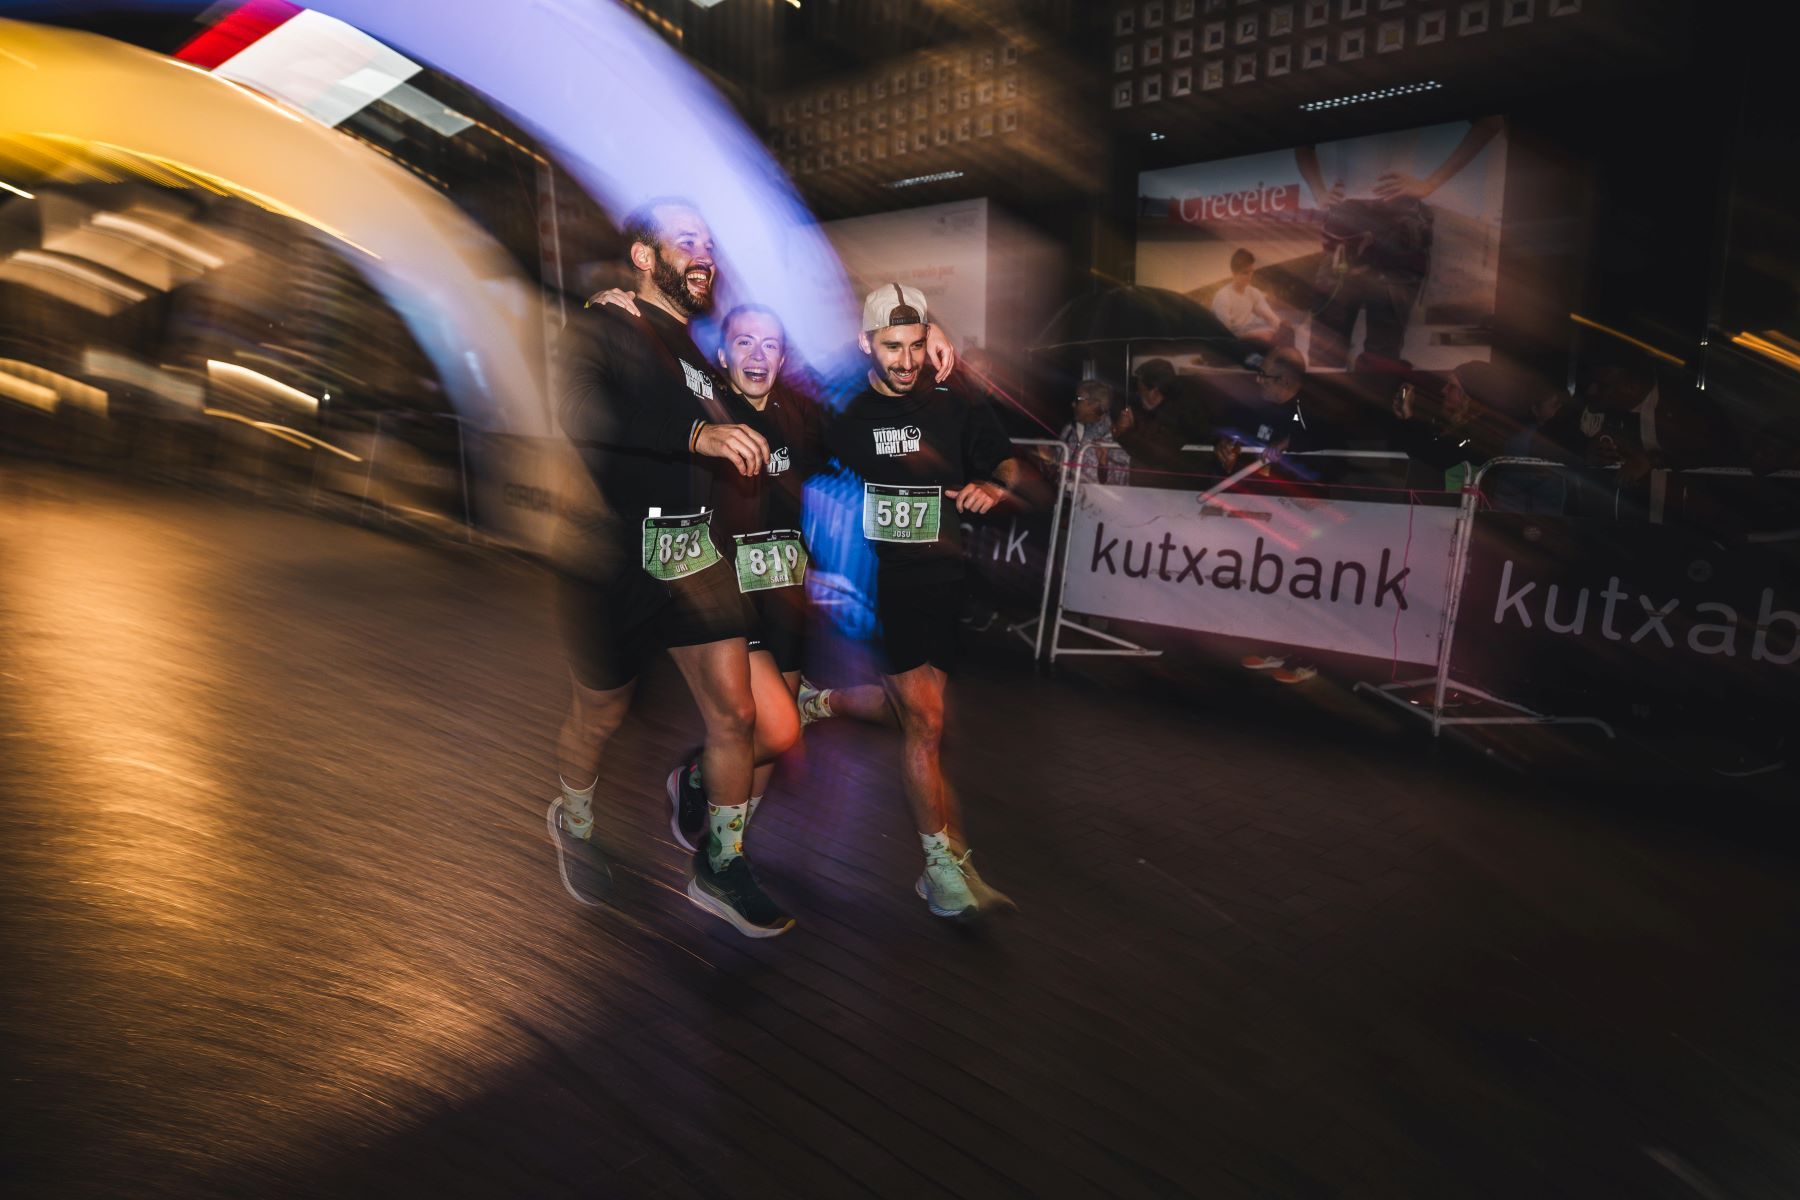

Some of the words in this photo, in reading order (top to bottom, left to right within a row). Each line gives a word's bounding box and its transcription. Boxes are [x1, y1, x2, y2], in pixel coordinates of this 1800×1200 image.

[873, 428, 907, 443] VITORIA
[876, 441, 901, 455] NIGHT
[902, 440, 920, 453] RUN
[877, 500, 928, 528] 587
[892, 530, 911, 538] JOSU
[659, 529, 701, 565] 833
[749, 544, 798, 576] 819
[1090, 521, 1411, 612] kutxabank
[770, 574, 789, 584] SARA
